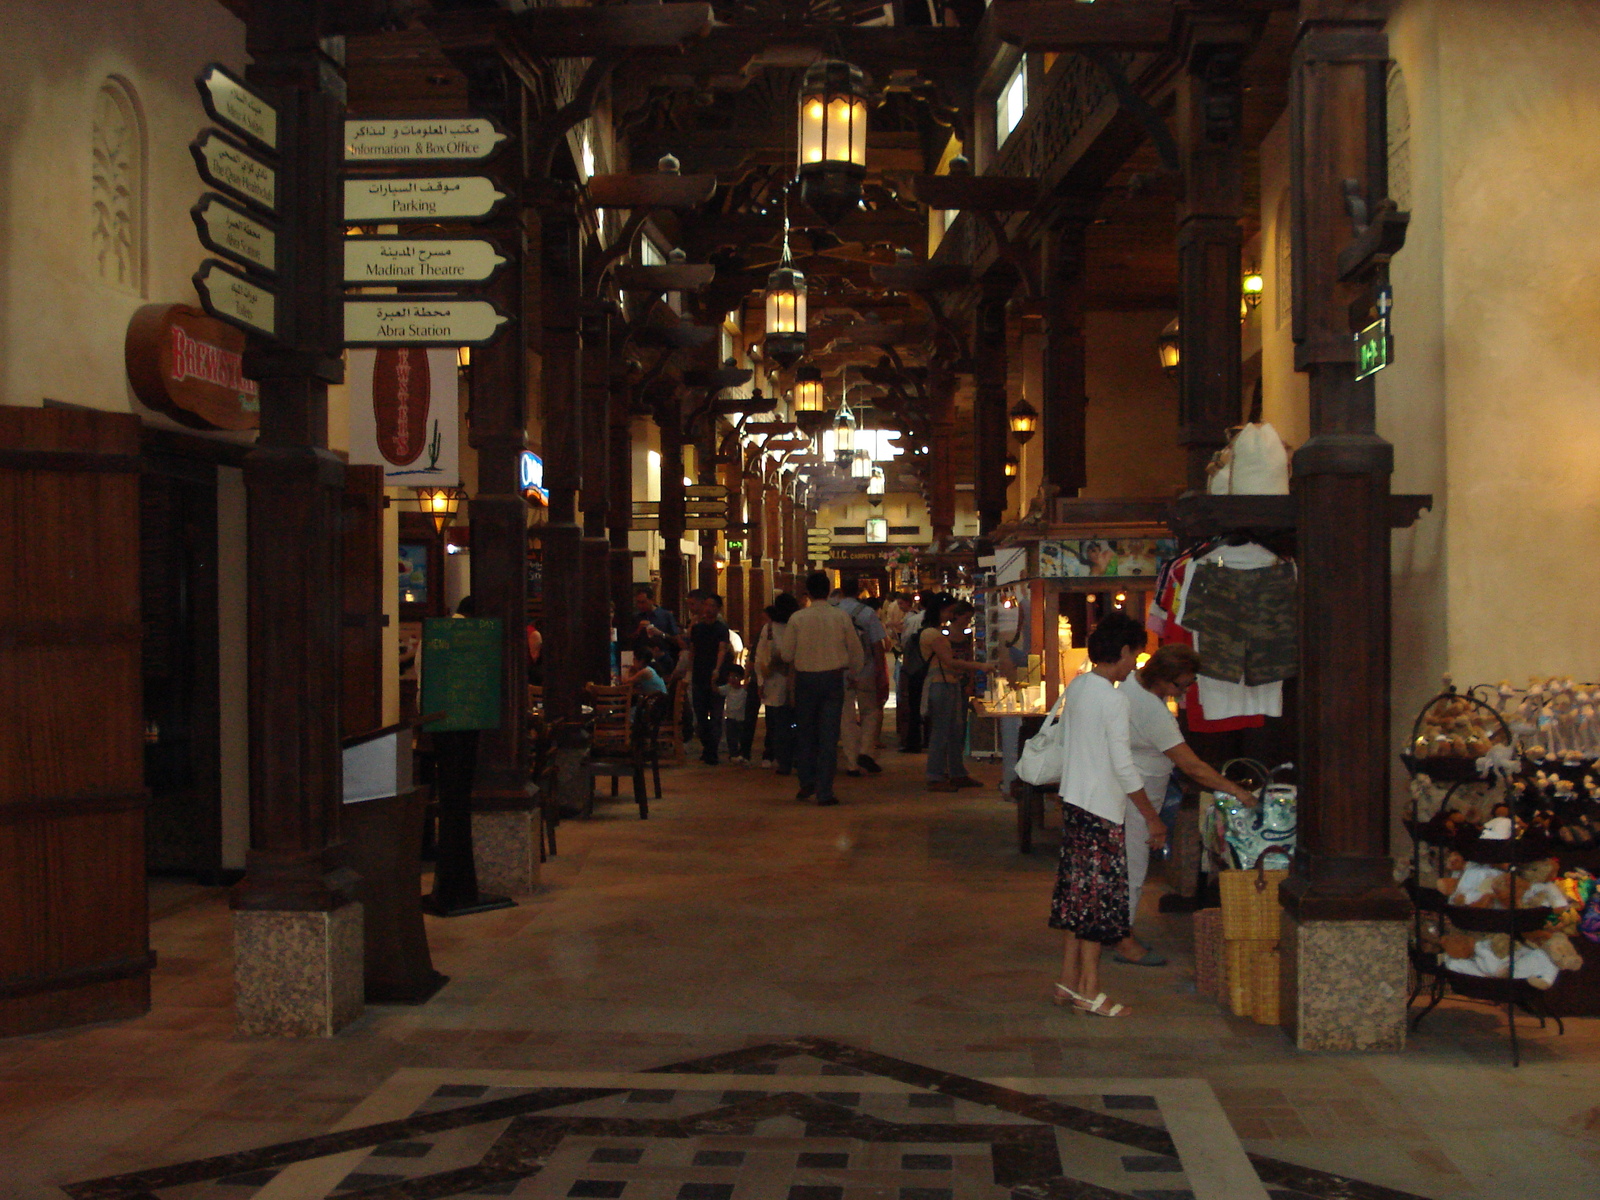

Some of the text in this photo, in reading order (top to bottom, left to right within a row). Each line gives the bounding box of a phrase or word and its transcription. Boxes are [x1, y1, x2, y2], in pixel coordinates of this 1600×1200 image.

[350, 141, 479, 155] Information & Box Office
[368, 181, 460, 196] موقف السيارات
[392, 200, 437, 213] Parking
[380, 246, 451, 261] مسرح المدينة
[366, 263, 464, 276] Madinat Theatre
[414, 307, 451, 317] محطة
[377, 324, 451, 336] Abra Station
[171, 323, 259, 396] BREWST
